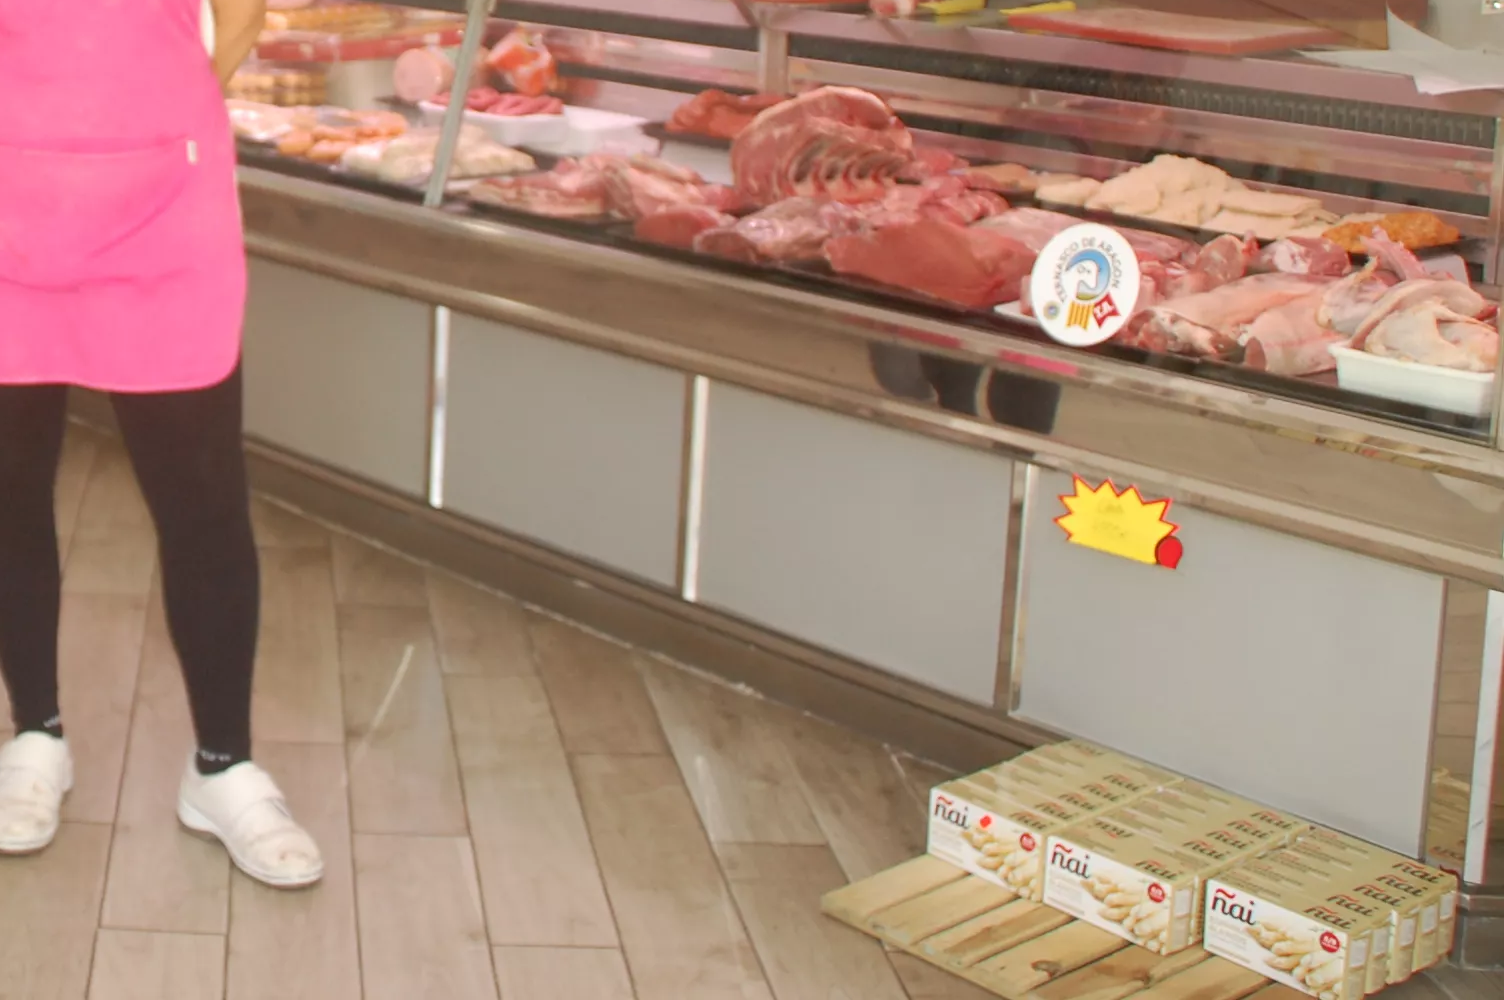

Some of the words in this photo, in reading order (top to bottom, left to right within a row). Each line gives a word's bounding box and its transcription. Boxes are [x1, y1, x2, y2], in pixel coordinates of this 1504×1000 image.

[1054, 241, 1079, 303] TERNASCO
[1081, 237, 1096, 247] DE
[933, 796, 970, 830] ñai
[1051, 843, 1092, 879] ñai
[1392, 860, 1446, 884] ñai
[1352, 884, 1408, 907] ñai
[1375, 874, 1429, 897] ñai
[1210, 887, 1257, 926] ñai
[1303, 905, 1357, 929] ñai
[1325, 894, 1380, 917] ñai
